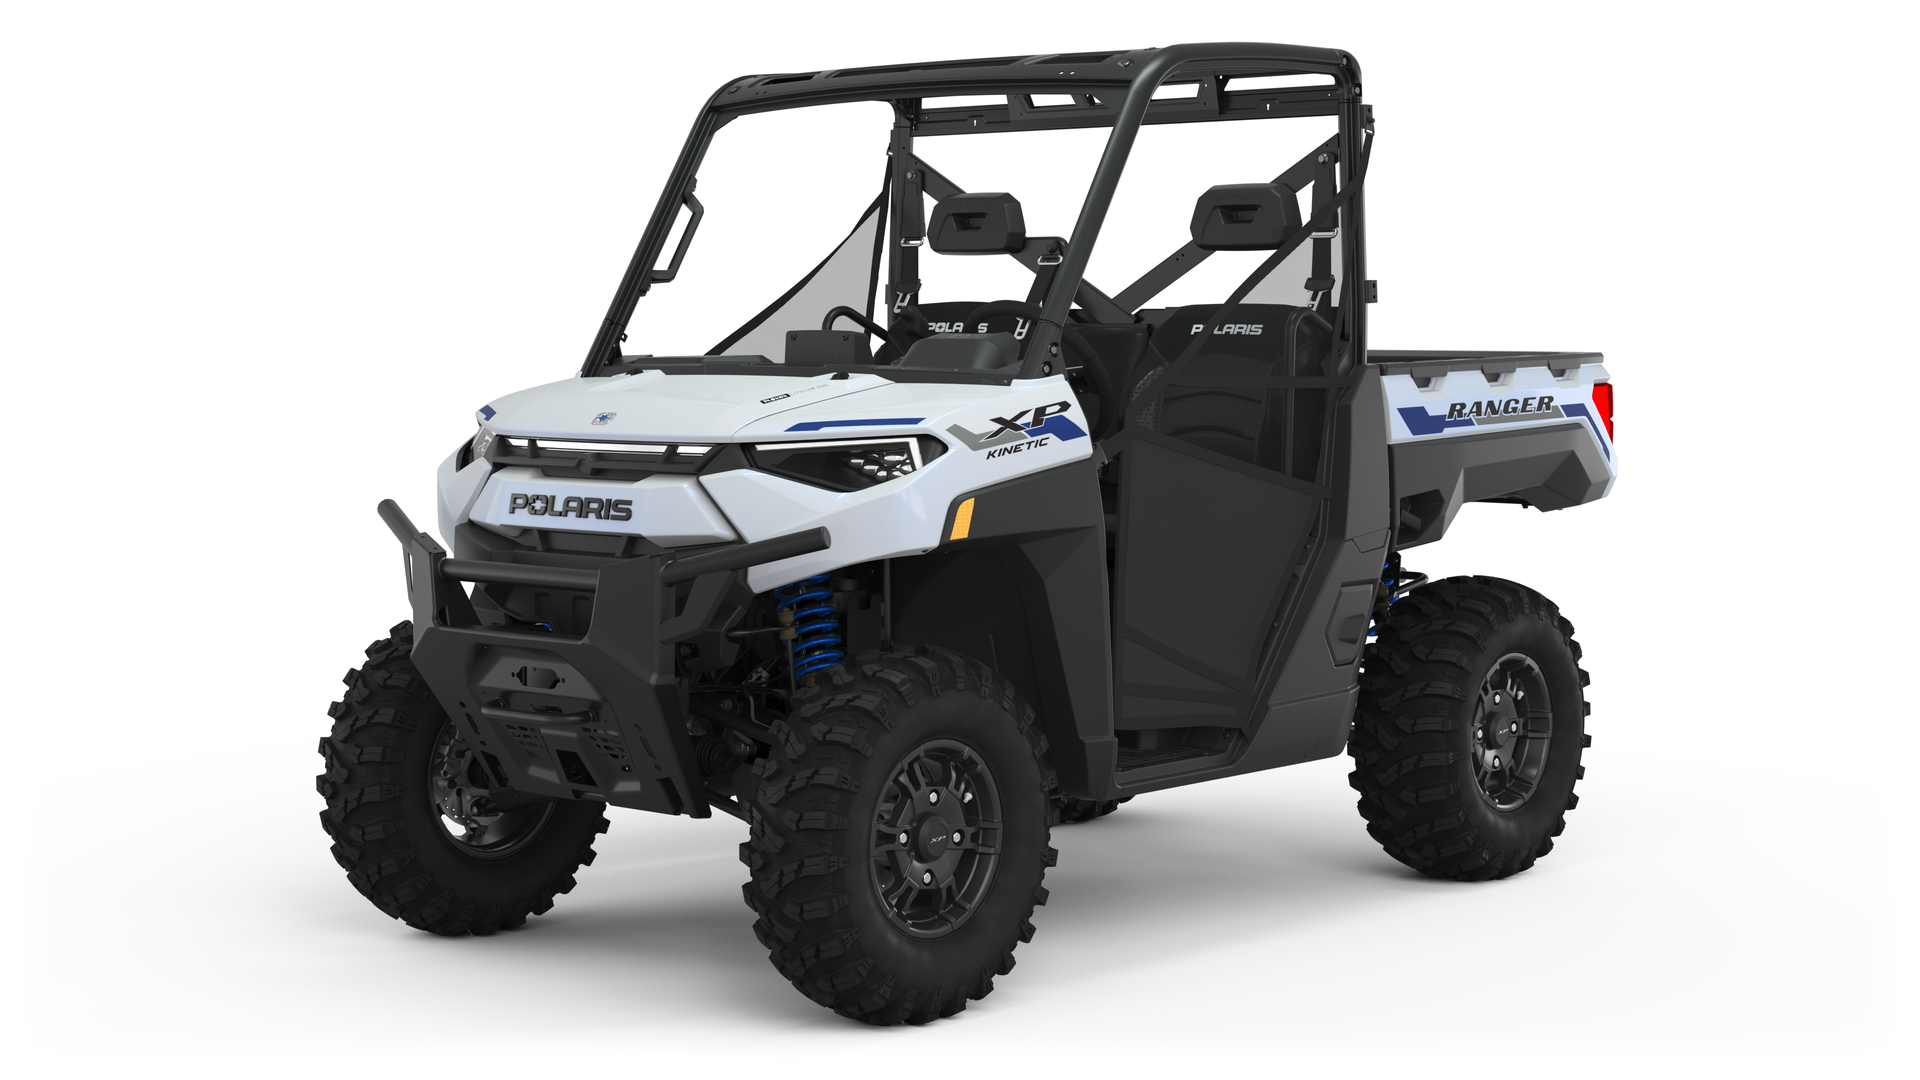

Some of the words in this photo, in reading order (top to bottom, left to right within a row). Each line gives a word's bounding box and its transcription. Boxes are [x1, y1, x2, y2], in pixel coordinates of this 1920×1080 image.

[927, 322, 989, 334] POLAS
[1190, 324, 1264, 335] PLARIS
[1446, 395, 1555, 420] RANGER
[983, 400, 1072, 440] XP
[986, 437, 1050, 460] KINETIC
[508, 492, 633, 521] POLARIS
[929, 835, 945, 844] XP
